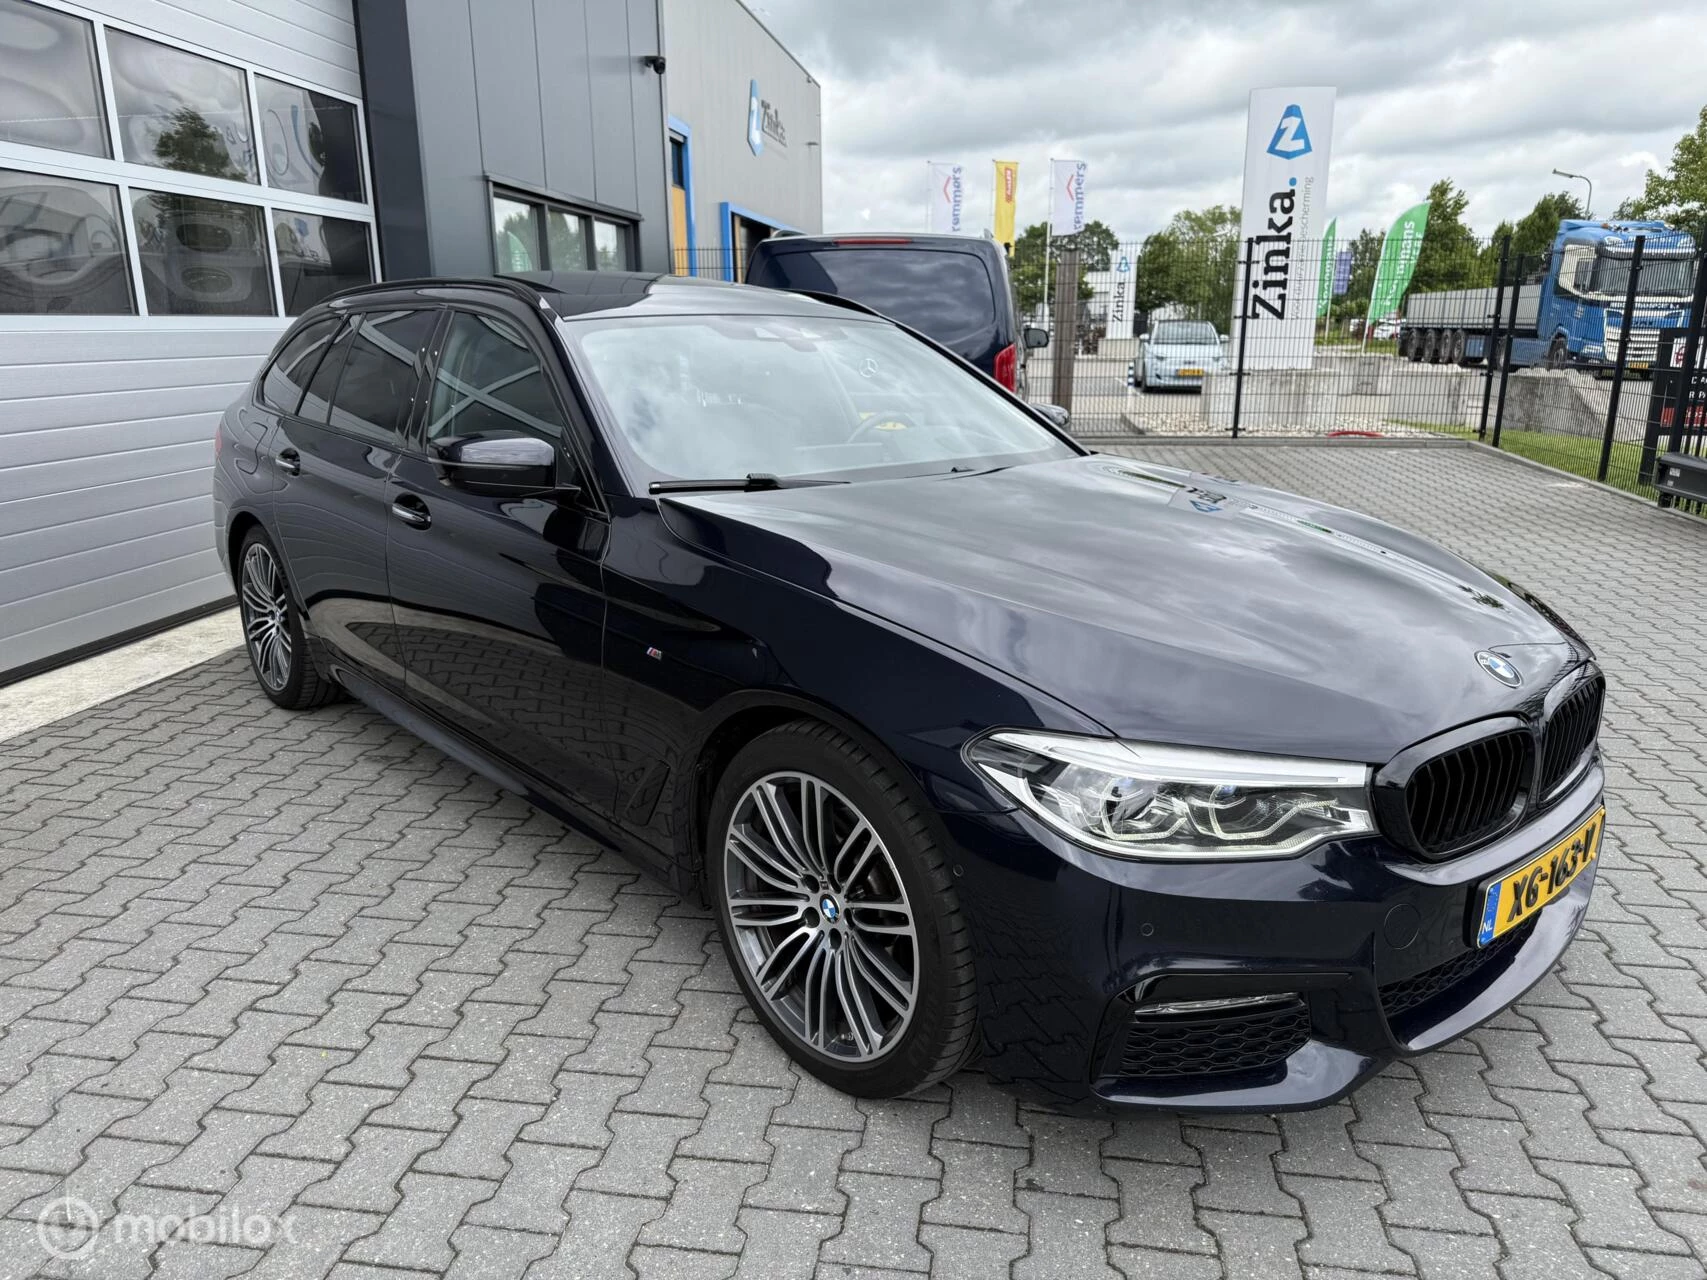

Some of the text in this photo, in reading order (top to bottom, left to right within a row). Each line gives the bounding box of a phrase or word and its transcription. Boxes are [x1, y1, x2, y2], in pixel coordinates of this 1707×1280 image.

[951, 166, 963, 232] remmers
[1073, 163, 1087, 231] remmers
[1296, 176, 1314, 242] bescherming
[1482, 919, 1493, 934] NL
